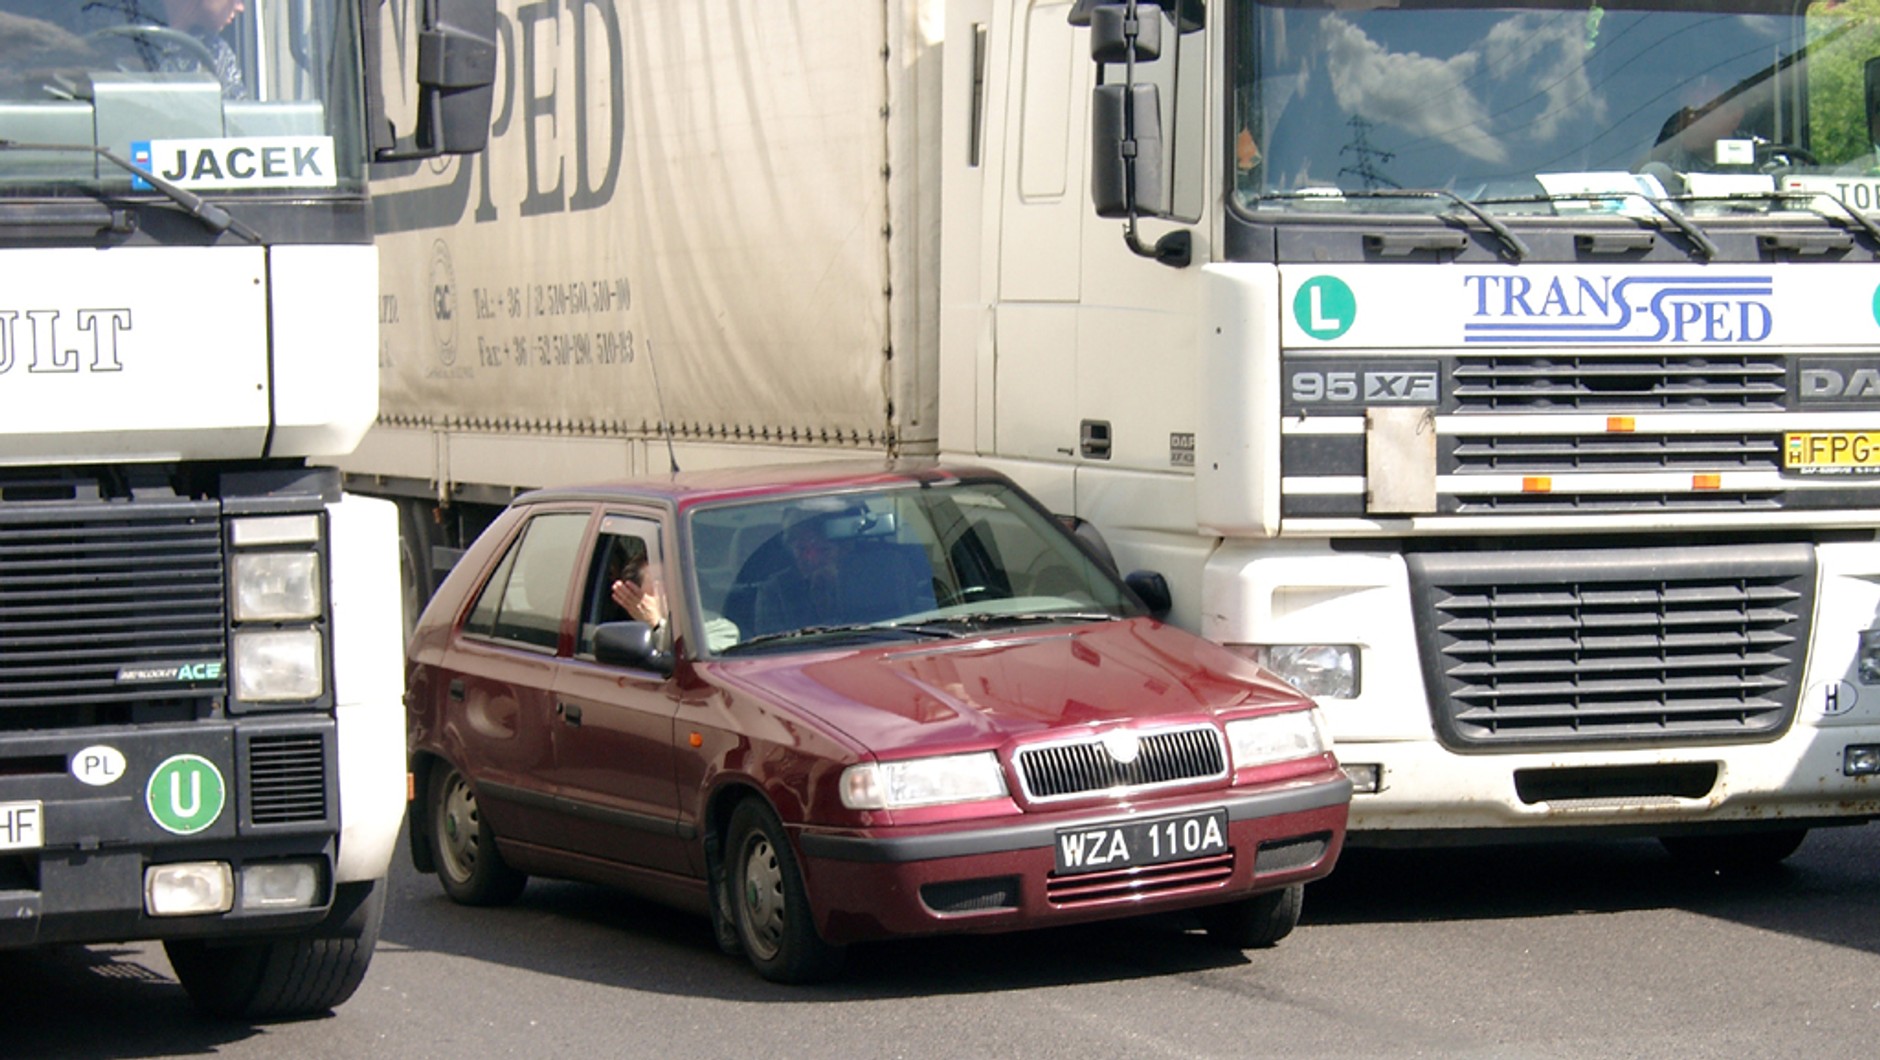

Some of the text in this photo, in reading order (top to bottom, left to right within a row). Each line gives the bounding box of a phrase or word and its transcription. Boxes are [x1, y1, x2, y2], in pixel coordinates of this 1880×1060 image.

[162, 146, 323, 182] JACEK
[1310, 286, 1340, 330] L
[1292, 372, 1434, 401] 95 XF
[177, 662, 222, 680] ACE
[1825, 683, 1838, 711] H
[85, 756, 115, 775] PL
[170, 770, 201, 818] U
[1061, 815, 1224, 867] WZA 110A
